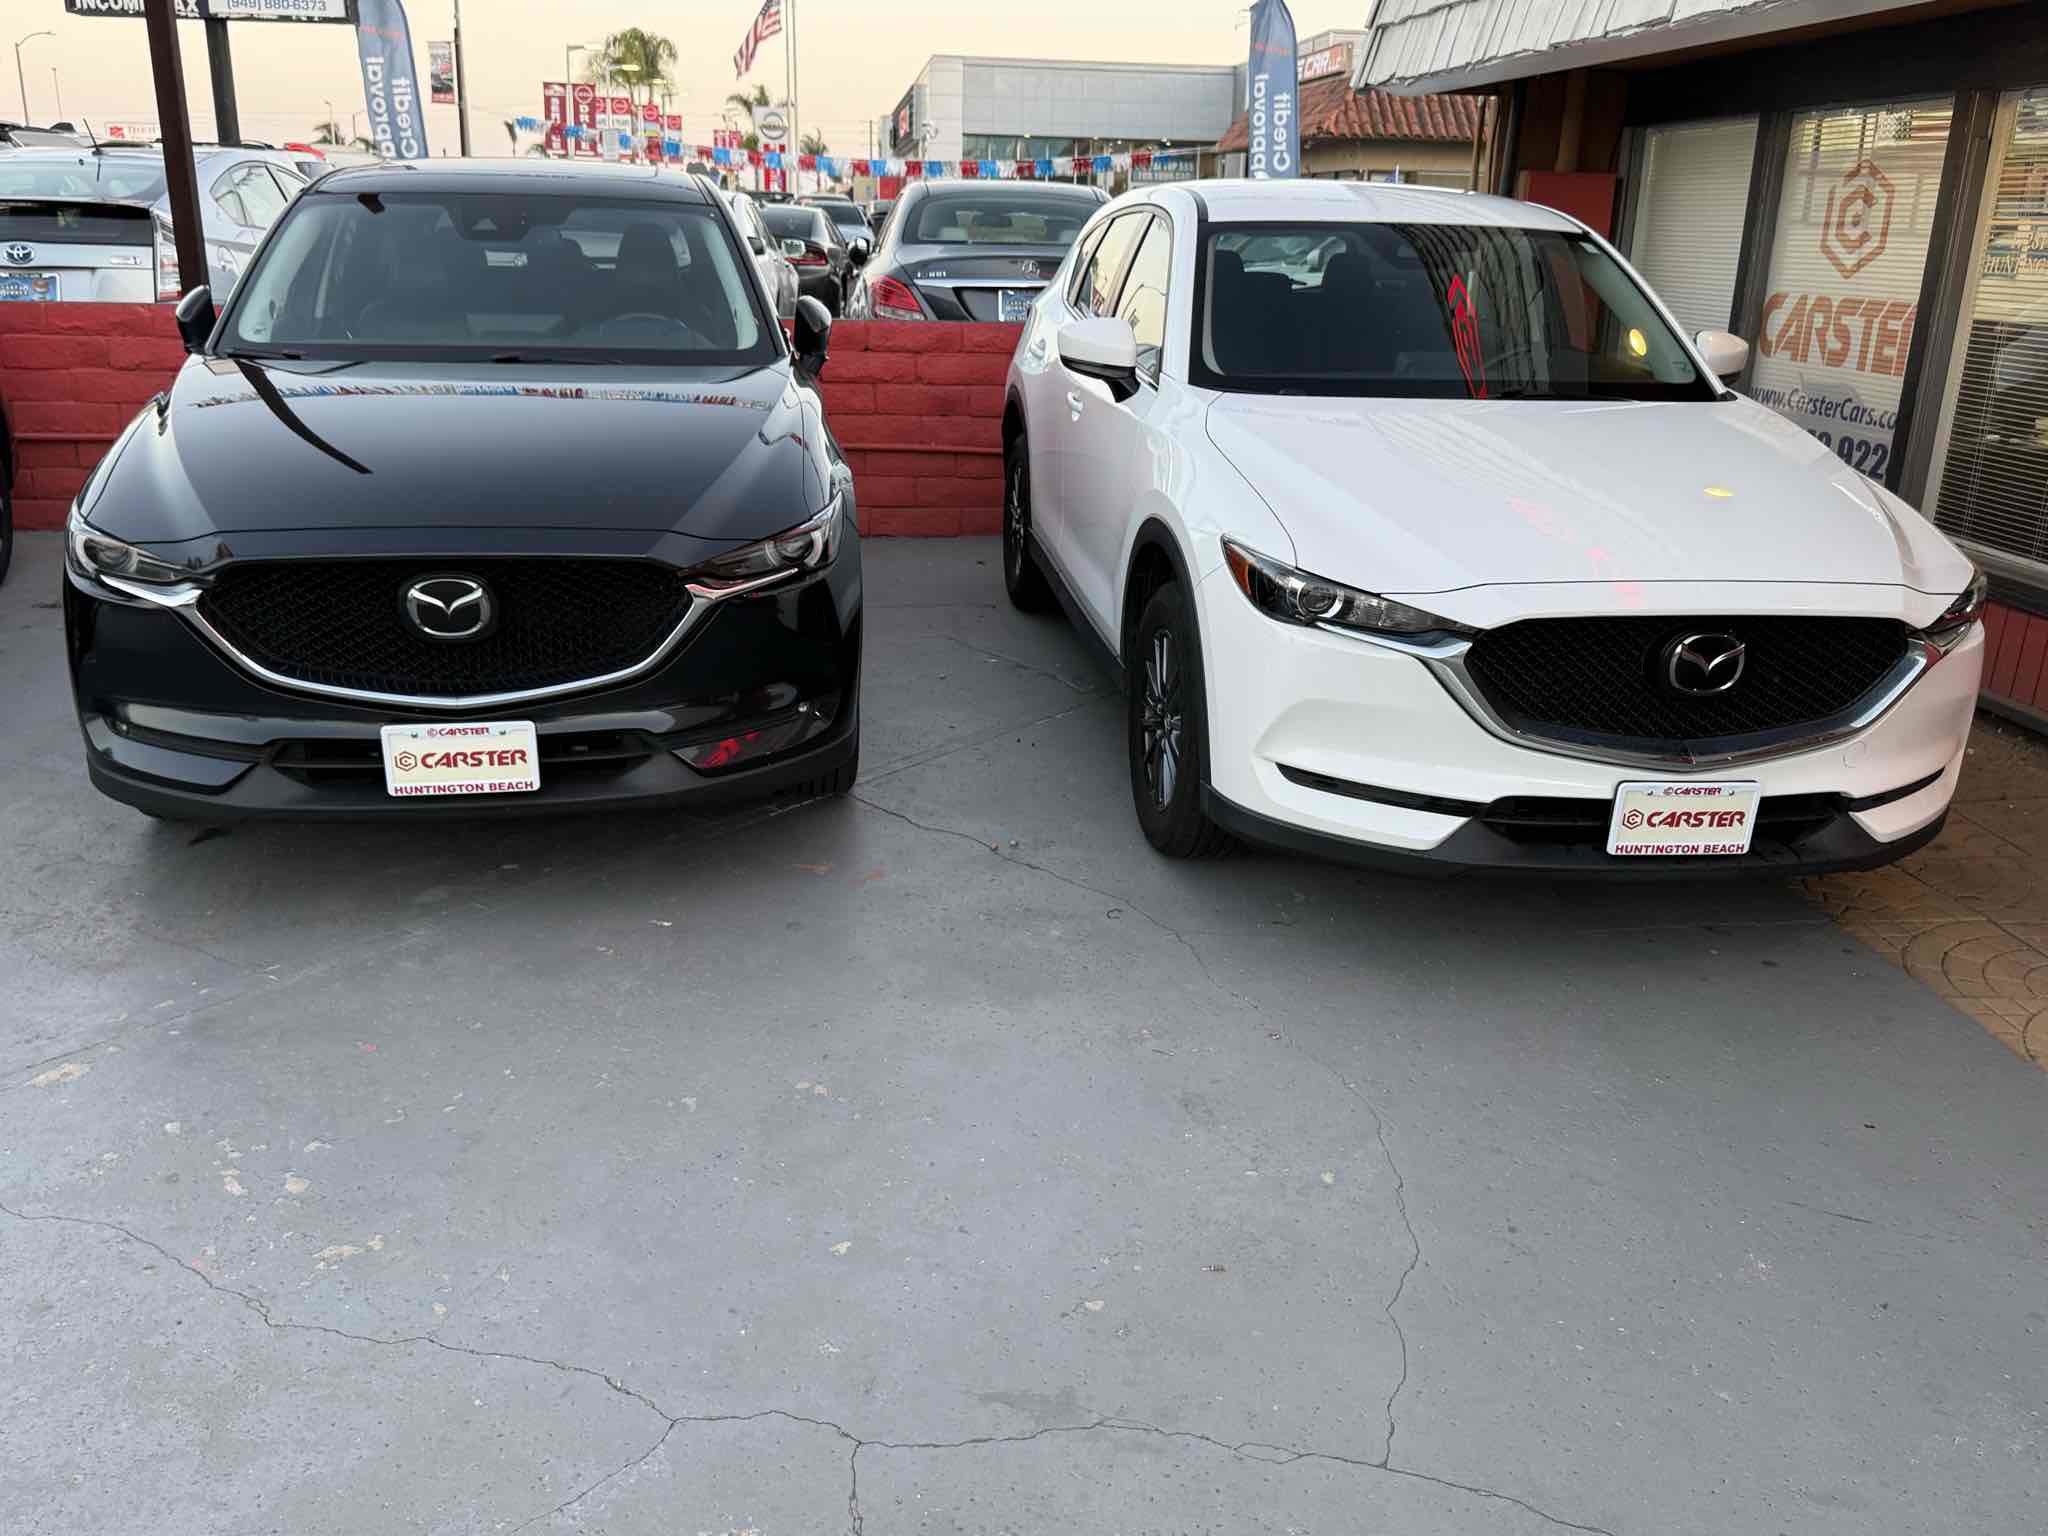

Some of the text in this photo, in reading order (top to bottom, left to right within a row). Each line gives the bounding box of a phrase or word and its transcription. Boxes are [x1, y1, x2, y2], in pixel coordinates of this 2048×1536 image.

[75, 0, 200, 12] INCOM AX
[1751, 386, 1897, 431] www.CarsterCars.co
[439, 727, 490, 737] CARSTER
[421, 750, 528, 769] CARSTER
[394, 781, 534, 795] HUNTINGTON BEACH
[1674, 787, 1722, 796] CARSTER
[1647, 811, 1746, 828] CARSTER
[1615, 844, 1745, 854] HUNTINGTON BEACH
